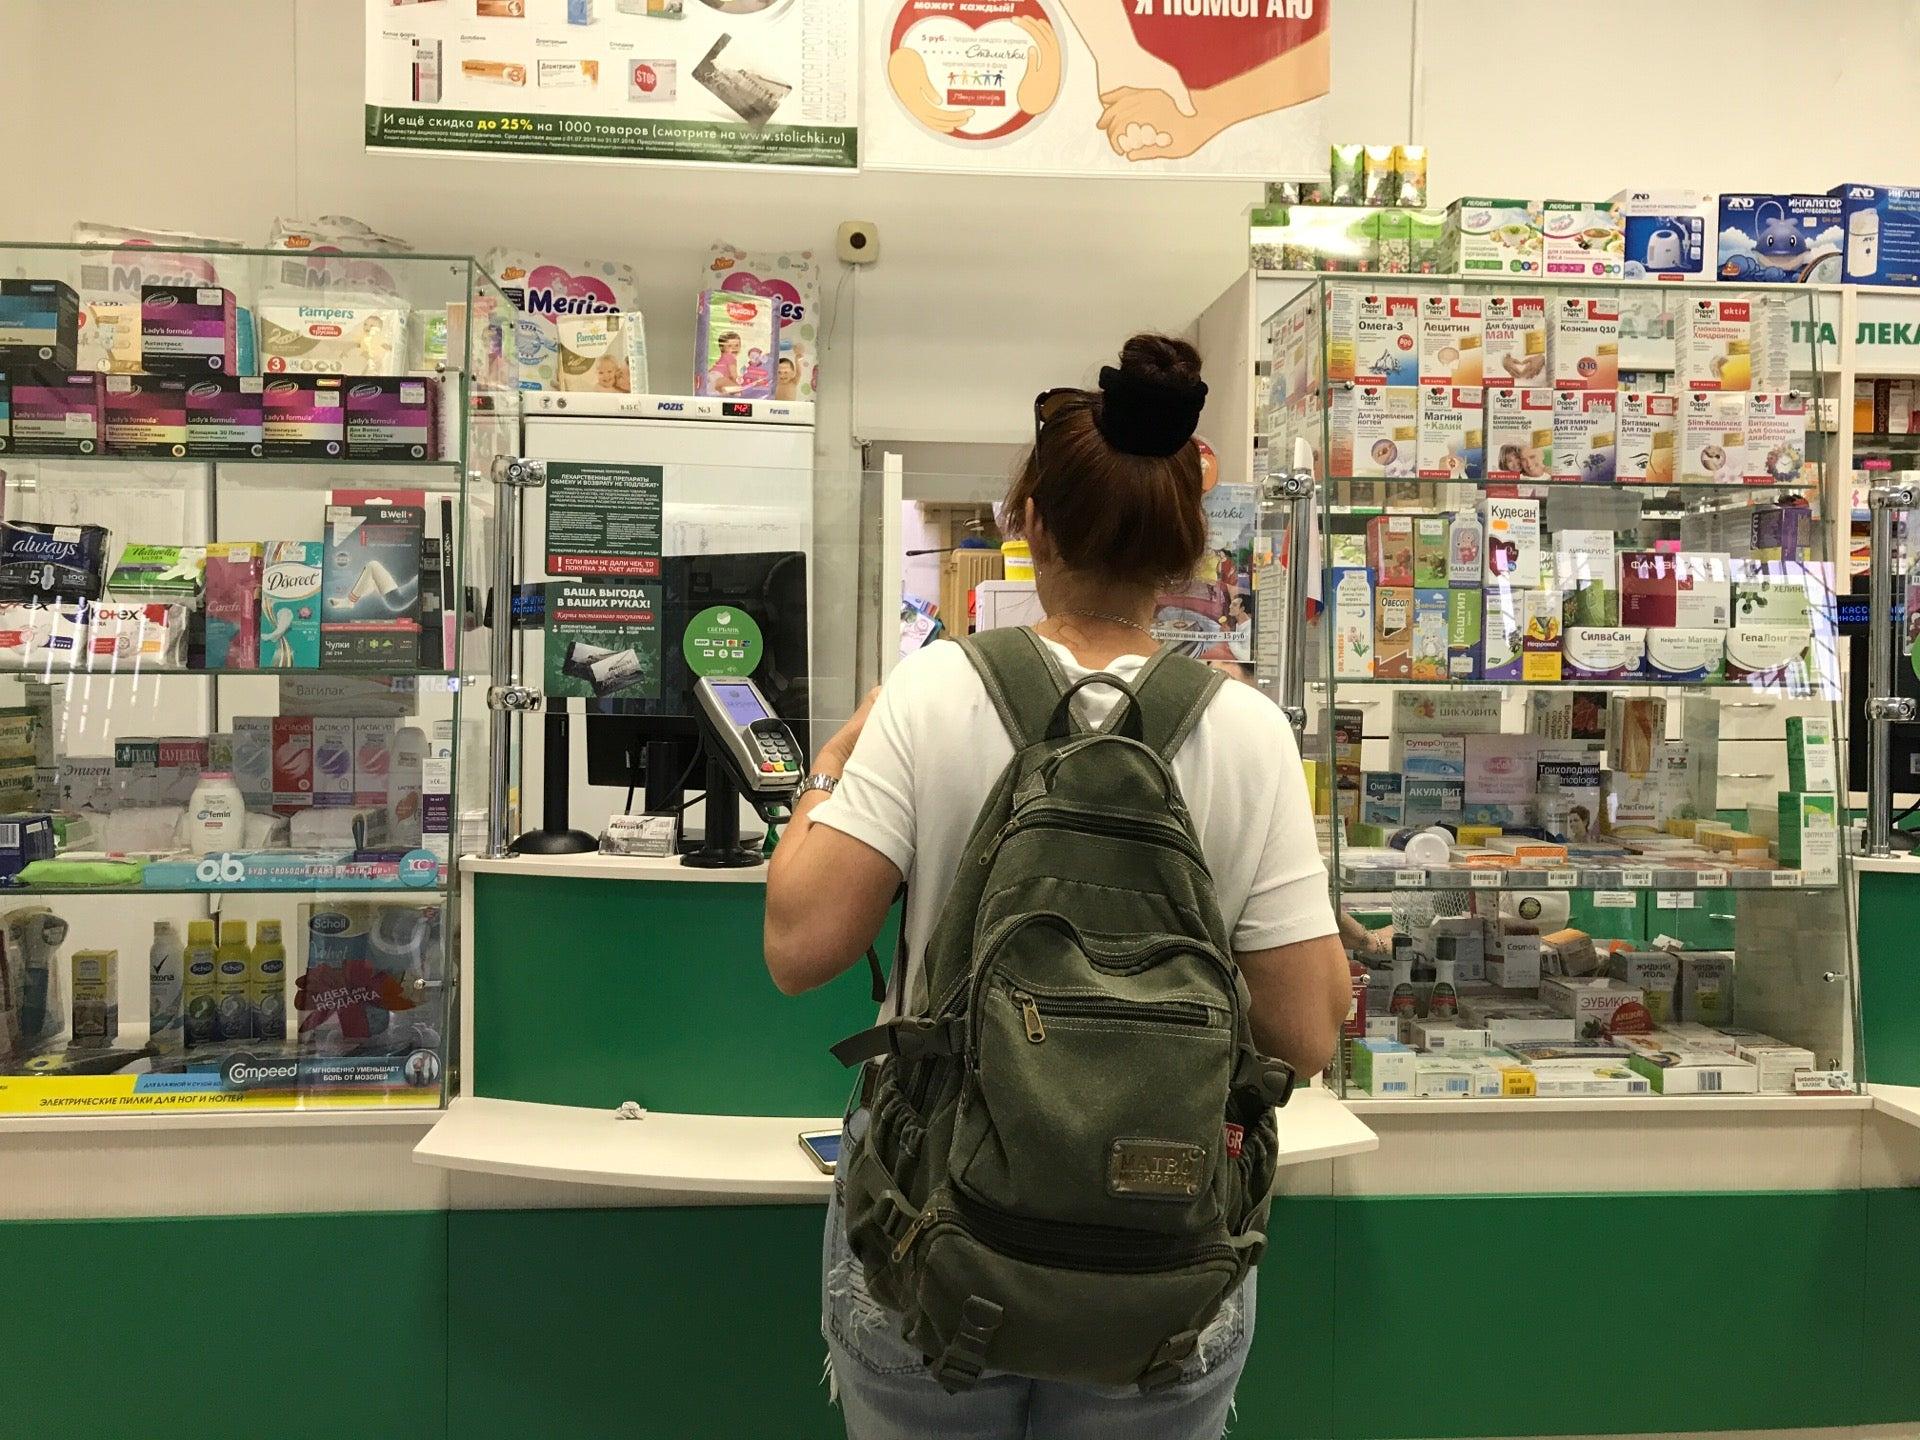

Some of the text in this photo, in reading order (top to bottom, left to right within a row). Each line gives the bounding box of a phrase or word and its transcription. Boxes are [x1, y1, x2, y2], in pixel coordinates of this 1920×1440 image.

[914, 2, 1014, 12] может каждый!
[636, 71, 657, 85] STOP
[384, 113, 394, 125] И
[399, 114, 424, 128] ещё
[429, 117, 474, 129] скидка
[478, 119, 496, 130] до
[501, 118, 533, 131] 25%
[538, 122, 552, 132] на
[558, 120, 592, 134] 1000
[596, 124, 648, 138] товаров
[652, 124, 716, 140] (смотрите
[720, 130, 735, 140] на
[740, 130, 846, 146] www.stolichki.ru)
[1849, 188, 1874, 198] AND
[1728, 198, 1754, 207] AND
[1789, 199, 1842, 208] ИНГАЛЯТОР
[298, 307, 354, 320] Pampers
[1358, 321, 1404, 330] Омега-3
[1424, 322, 1470, 332] Лецитин
[1502, 322, 1534, 332] будущих
[1560, 324, 1616, 334] Коэнзим Q10
[576, 332, 606, 343] Pampers
[1486, 330, 1514, 340] мам
[1694, 333, 1738, 341] Хондроитин
[272, 358, 281, 370] 3
[1579, 362, 1596, 370] Q10
[658, 402, 684, 412] POZIS
[1424, 412, 1462, 421] Магний
[1424, 421, 1462, 430] +Калий
[1622, 419, 1660, 427] Витамины
[1492, 505, 1536, 519] Кудесан
[12, 536, 78, 560] always
[29, 570, 40, 585] 5
[268, 573, 316, 591] Discreet
[564, 588, 644, 598] ВАША ВЫГОДА
[558, 598, 650, 608] В ВАШИХ РУКАХ!
[1382, 598, 1410, 608] Овесол
[1232, 633, 1244, 642] руб
[1581, 631, 1631, 642] СилваСан
[1688, 635, 1718, 644] Магний
[1741, 632, 1788, 644] ГепаЛонг
[325, 640, 350, 649] Чулки
[296, 685, 345, 697] Вагилак
[1440, 709, 1498, 718] ЦИКЛОВИТА
[1406, 739, 1460, 748] СуперОптик
[64, 764, 110, 776] Эпиген
[1540, 764, 1600, 774] Трихолоджик
[1560, 776, 1598, 784] tricologic
[1410, 788, 1462, 797] АКУЛАВИТ
[196, 853, 245, 884] o.b.
[248, 866, 266, 876] БУДЬ
[271, 866, 309, 876] СВОБОДНА
[314, 918, 346, 929] Scholl
[1637, 963, 1670, 971] ЖИДКИЙ
[1692, 963, 1726, 972] ЖИДКИЙ
[1698, 970, 1720, 978] УГОЛЬ
[312, 987, 349, 1002] ИДЕЯ
[316, 990, 381, 1012] ПОДАРКА
[229, 1062, 298, 1084] Compeed
[40, 1098, 116, 1107] ЭЛЕКТРИЧЕСКИЕ
[120, 1096, 152, 1105] ПИЛКИ
[154, 1096, 176, 1106] ДЛЯ
[178, 1095, 198, 1104] НОГ
[208, 1093, 244, 1103] НОГТЕЙ
